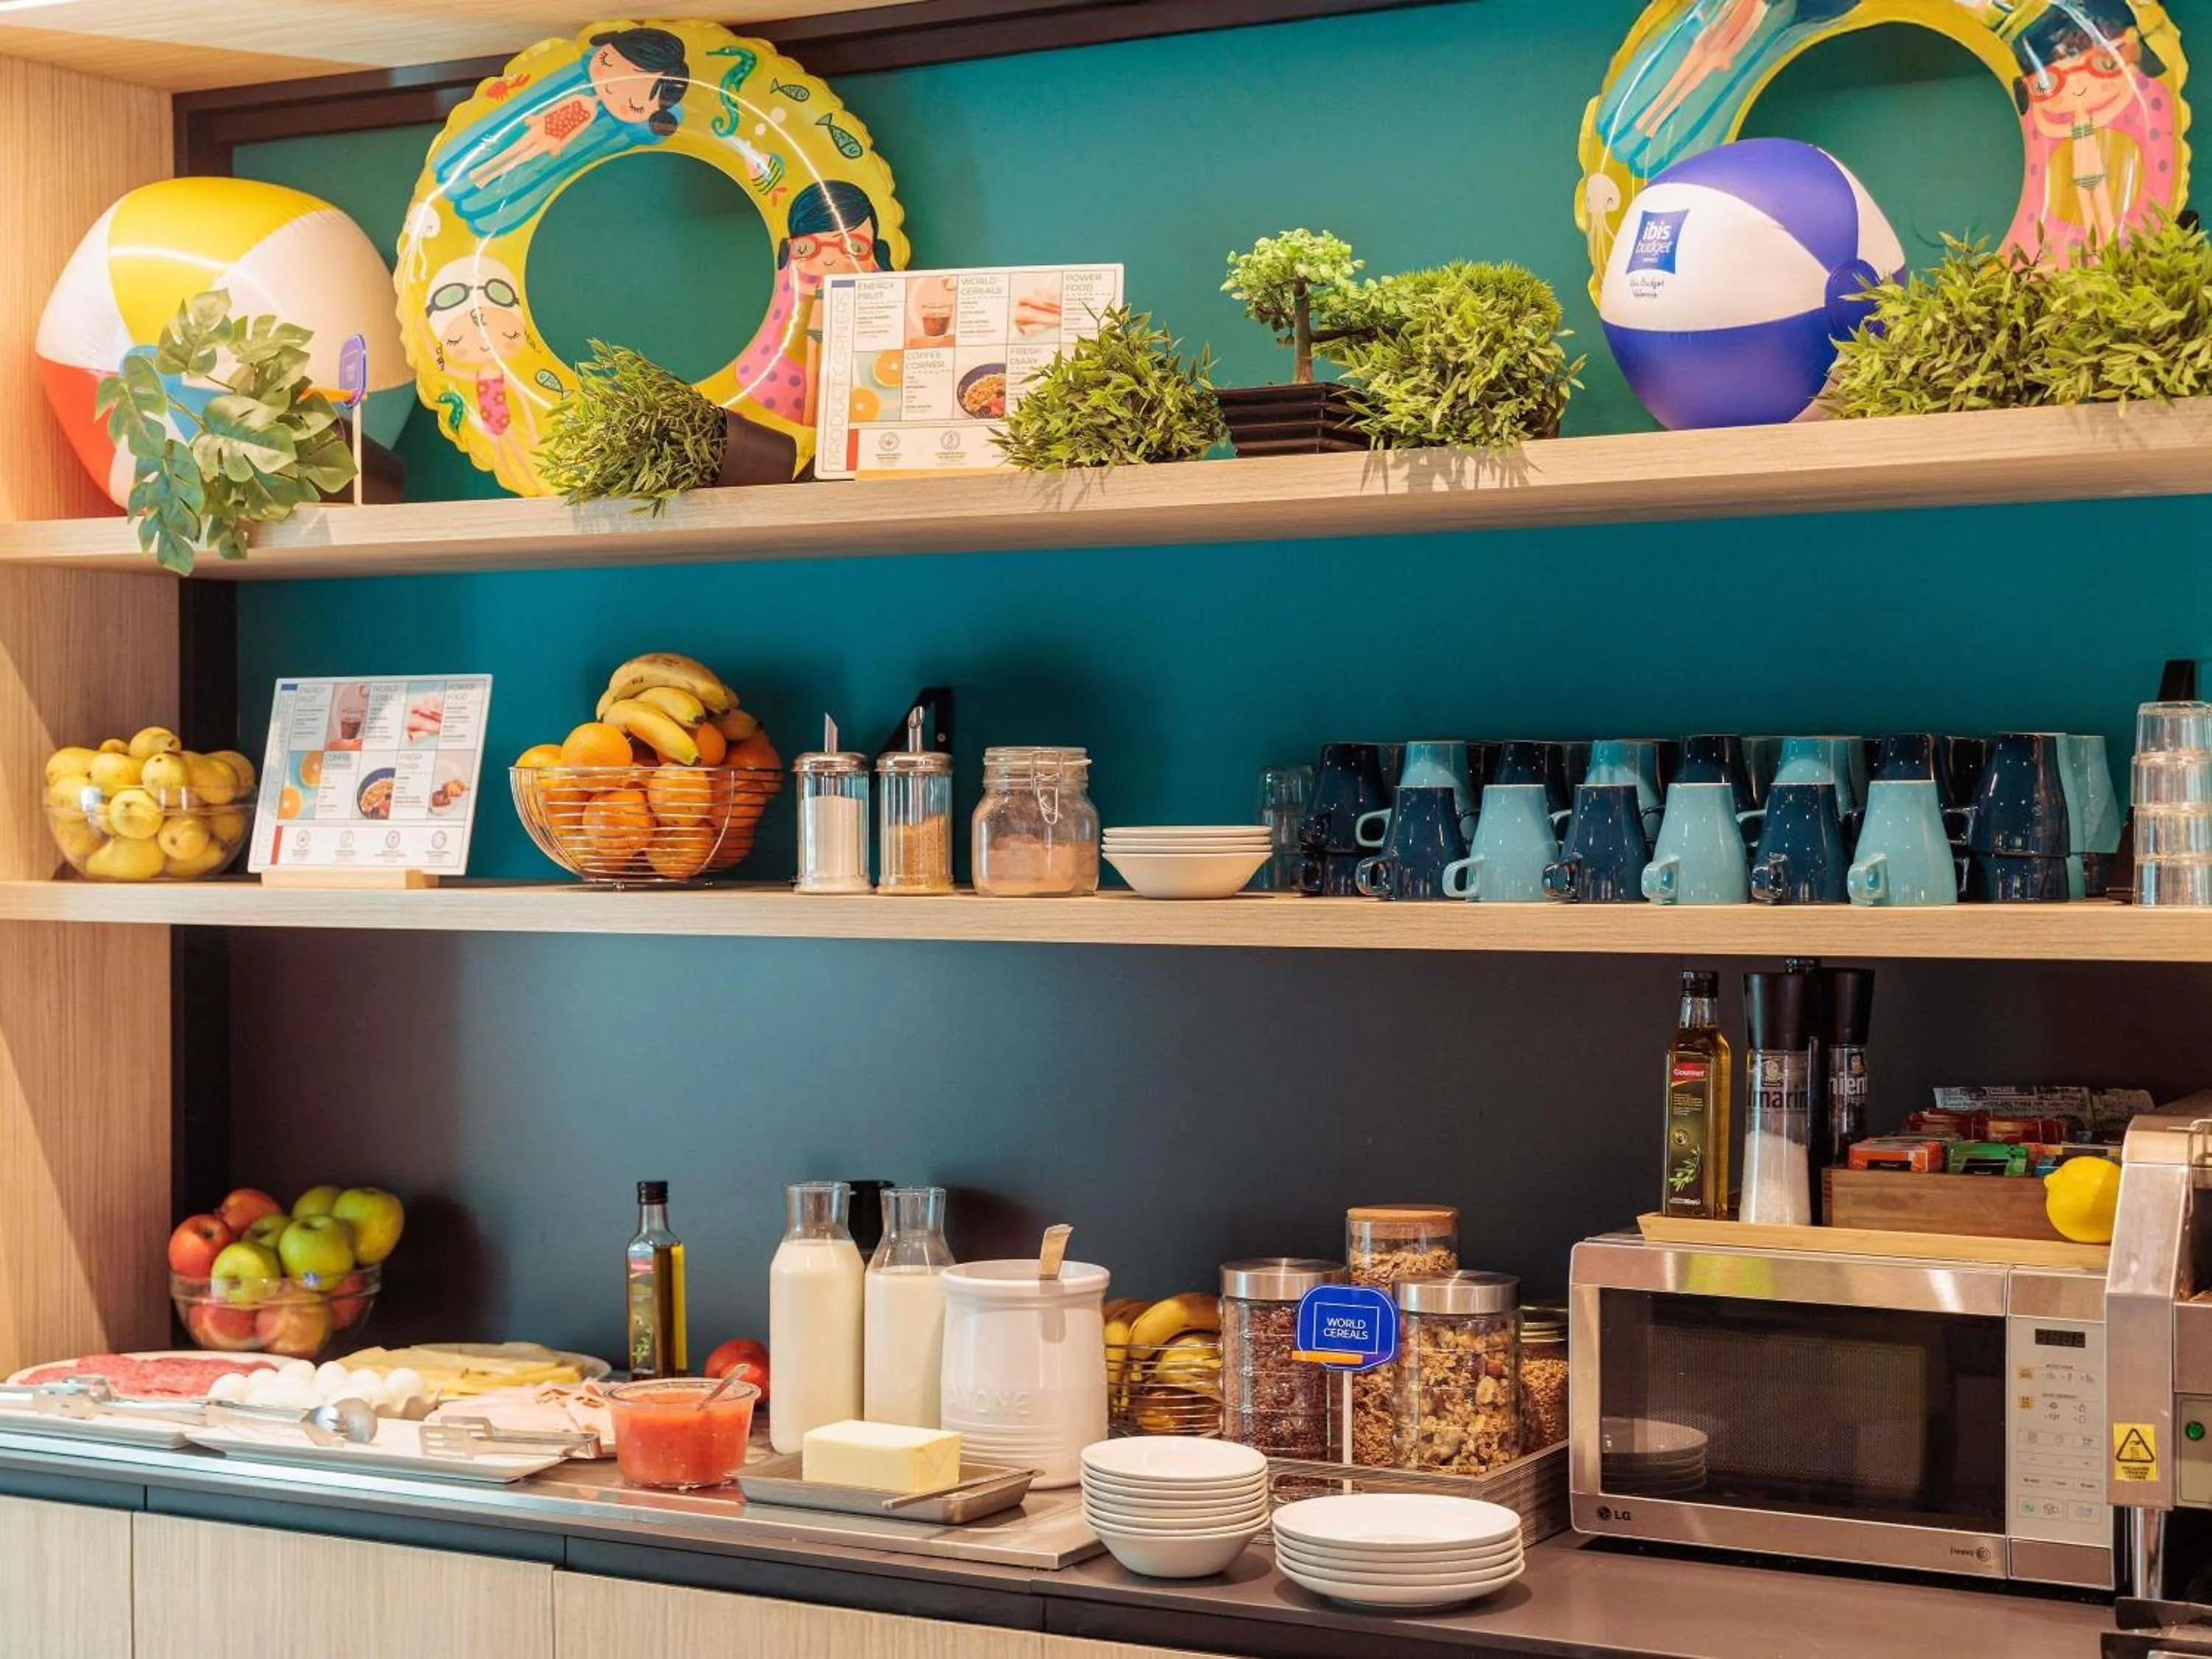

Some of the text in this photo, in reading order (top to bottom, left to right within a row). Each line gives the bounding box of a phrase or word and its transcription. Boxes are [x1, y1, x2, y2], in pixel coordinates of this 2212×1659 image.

[1643, 221, 1672, 240] ibis
[1635, 240, 1673, 256] budget
[960, 276, 997, 286] WORLD
[1065, 273, 1102, 282] POWER
[960, 285, 1003, 296] CEREALS
[1065, 282, 1093, 292] FOOD
[906, 350, 942, 361] COFFEE
[1673, 1068, 1705, 1078] Gourmet
[1754, 1085, 1808, 1108] marin
[1326, 1317, 1366, 1329] WORLD
[1323, 1328, 1368, 1340] CEREALS
[1614, 1509, 1632, 1521] LG
